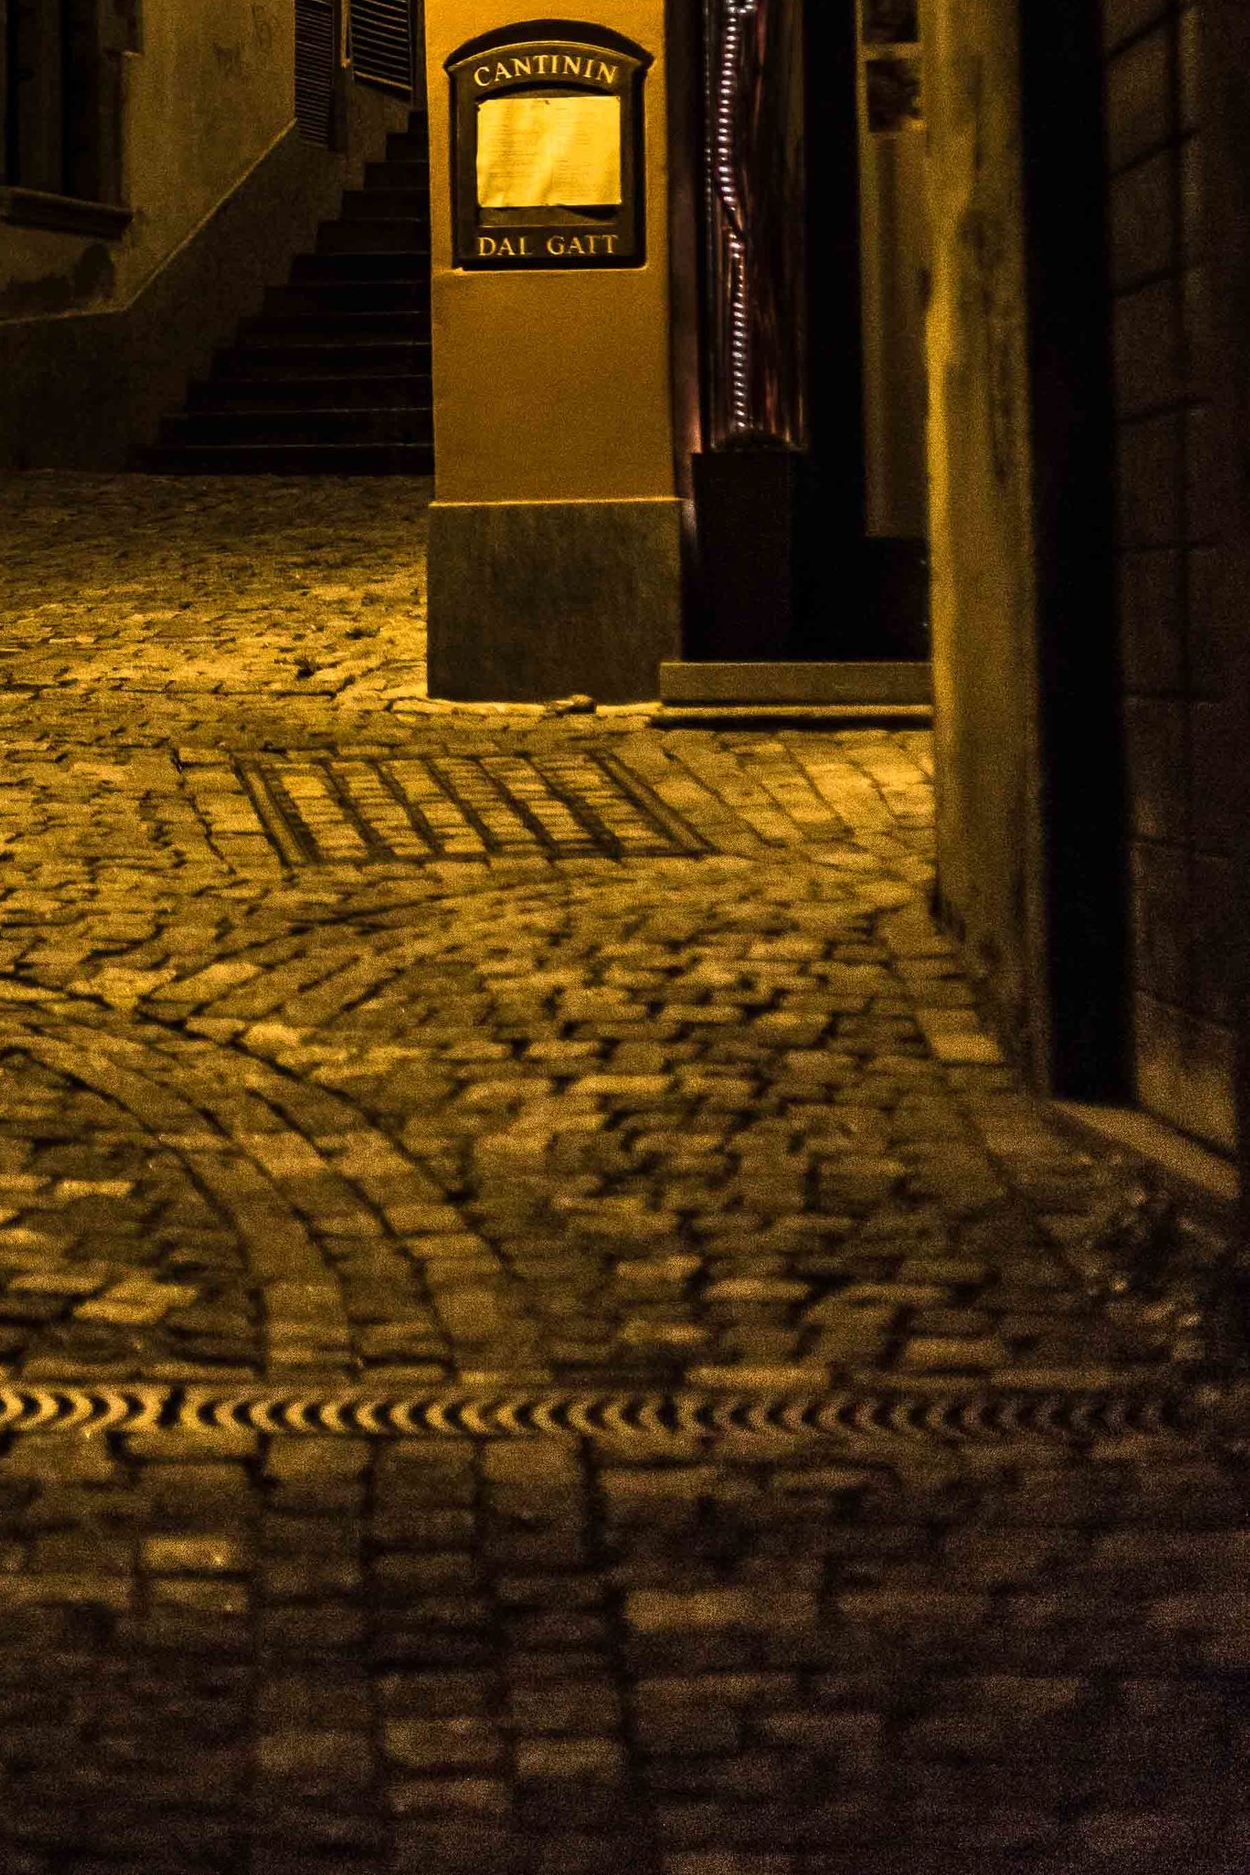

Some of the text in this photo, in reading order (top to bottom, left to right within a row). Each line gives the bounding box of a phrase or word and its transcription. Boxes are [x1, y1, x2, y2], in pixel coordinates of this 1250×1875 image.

[474, 55, 618, 86] CANTININ
[478, 235, 618, 256] DAL GATT
